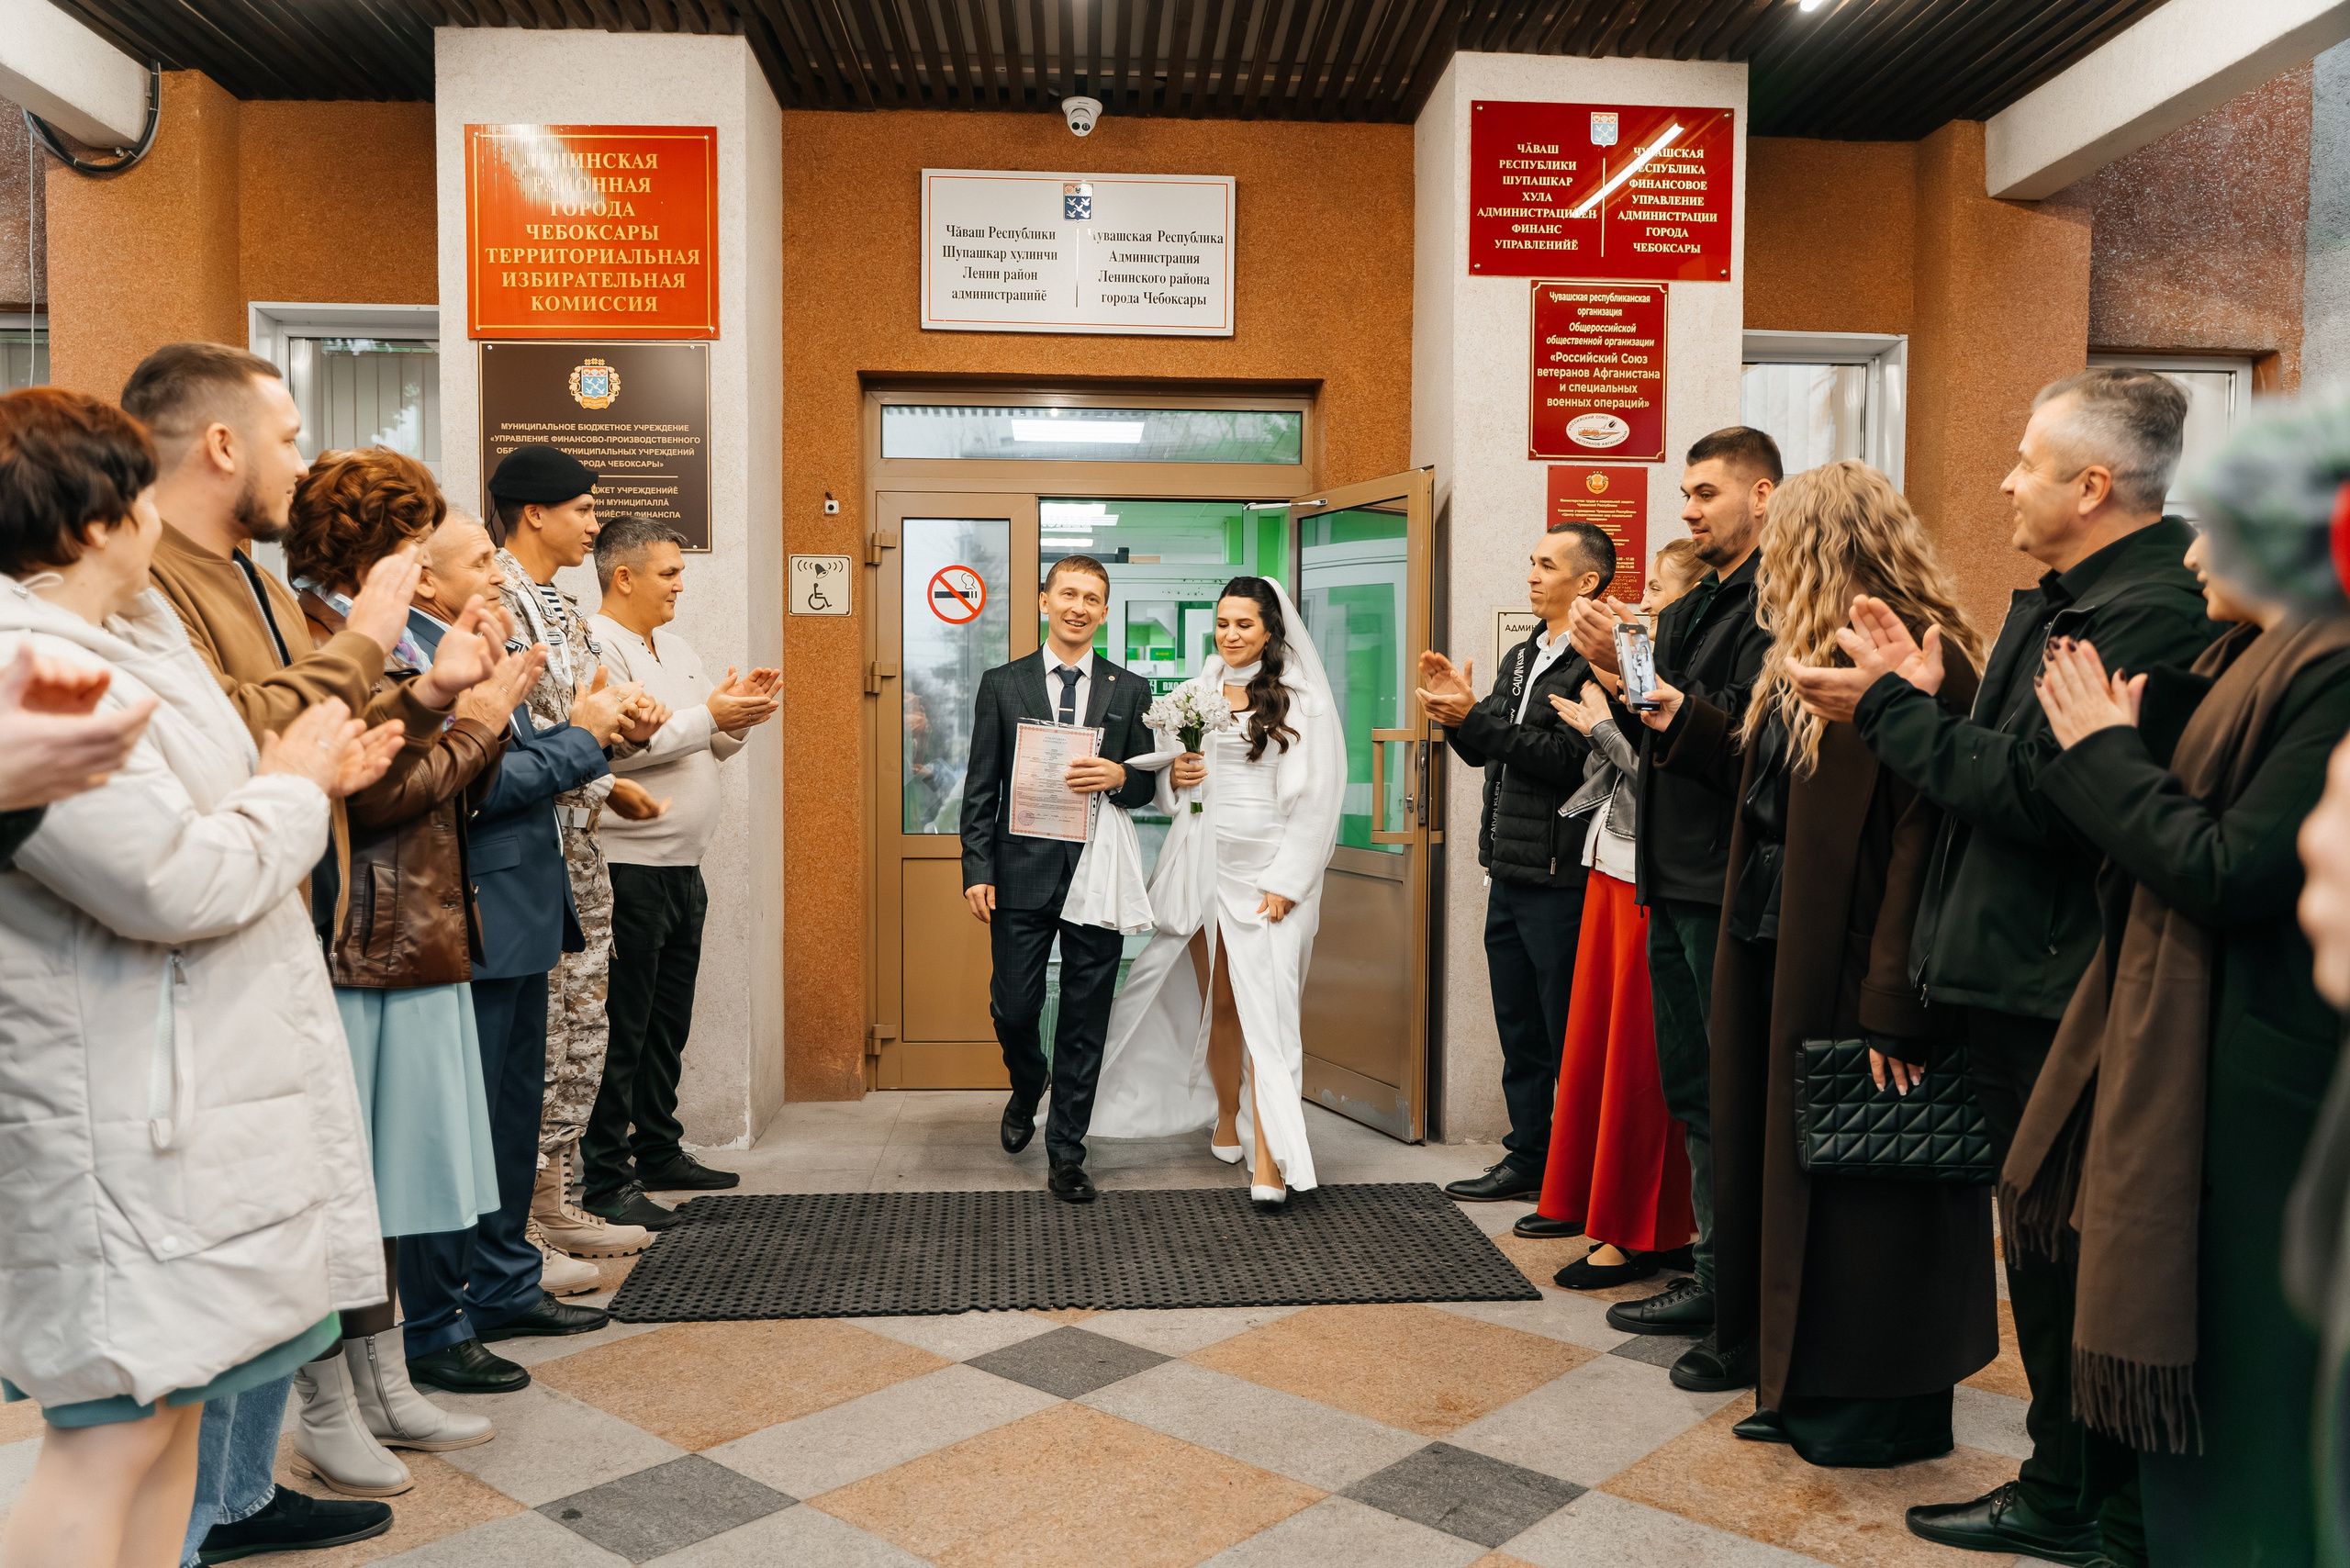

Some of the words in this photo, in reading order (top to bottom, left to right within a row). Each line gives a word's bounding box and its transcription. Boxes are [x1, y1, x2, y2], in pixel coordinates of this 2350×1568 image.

[1633, 147, 1704, 159] ЧУАШСКАЯ
[1499, 160, 1577, 171] РЕСПУБЛИКИ
[1633, 163, 1706, 175] ЕСПУБЛИКА
[1502, 175, 1573, 187] ШУПАШКАР
[1628, 179, 1707, 191] ФИНАНСОВОЕ
[1522, 192, 1552, 203] ХУЛА
[1632, 195, 1705, 207] УПРАВЛЕНИЕ
[551, 201, 635, 219] ГОРОДА
[1617, 210, 1718, 223] АДМИНИСТРАЦИИ
[525, 224, 659, 241] ЧЕБОКСАРЫ
[989, 226, 1056, 243] Республики
[1511, 223, 1562, 234] ФИНАНС
[1646, 227, 1688, 239] ГОРОДА
[1157, 230, 1224, 246] Республика
[942, 245, 1007, 262] Шупашкар
[1011, 251, 1058, 262] хулинчи
[1633, 242, 1701, 253] ЧЕБОКСАРЫ
[486, 248, 700, 264] ТЕРРИТОРИАЛЬНАЯ
[1109, 250, 1200, 266] Администрация
[501, 272, 686, 288] ИЗБИРАТЕЛЬНАЯ
[963, 266, 1000, 280] Ленин
[1003, 268, 1038, 283] район
[1098, 270, 1166, 284] Ленинского
[1169, 273, 1210, 287] района
[1102, 294, 1139, 307] города
[1143, 292, 1207, 308] Чебоксары
[1550, 291, 1588, 304] Чувашская
[1589, 292, 1651, 304] республиканская
[531, 296, 658, 312] КОМИССИЯ
[1577, 308, 1623, 318] организация
[1569, 322, 1637, 334] Общероссийской
[1546, 335, 1603, 346] общественной
[1604, 336, 1655, 347] организации
[1550, 352, 1618, 364] «Российский
[1621, 353, 1648, 364] Союз
[1537, 368, 1590, 380] ветеранов
[1593, 367, 1661, 381] Афганистана
[1560, 384, 1566, 392] и
[1568, 384, 1638, 394] специальных
[1547, 398, 1592, 408] военных
[1594, 398, 1650, 409] операций»
[500, 423, 576, 432] МУНИЦИПАЛЬНОЕ
[577, 423, 632, 432] БЮДЖЕТНОЕ
[633, 424, 689, 432] УЧРЕЖДЕНИЕ
[490, 434, 549, 442] «УПРАВЛЕНИЕ
[551, 435, 700, 444] ФИНАНСОВО-ПРОИЗВОДСТВЕННОГО
[561, 447, 636, 456] МУНИЦИПАЛЬНЫХ
[638, 446, 695, 457] УЧРЕЖДЕНИЙ
[608, 460, 664, 468] ЧЕБОКСАРЫ»
[1512, 665, 1525, 696] CALVIN
